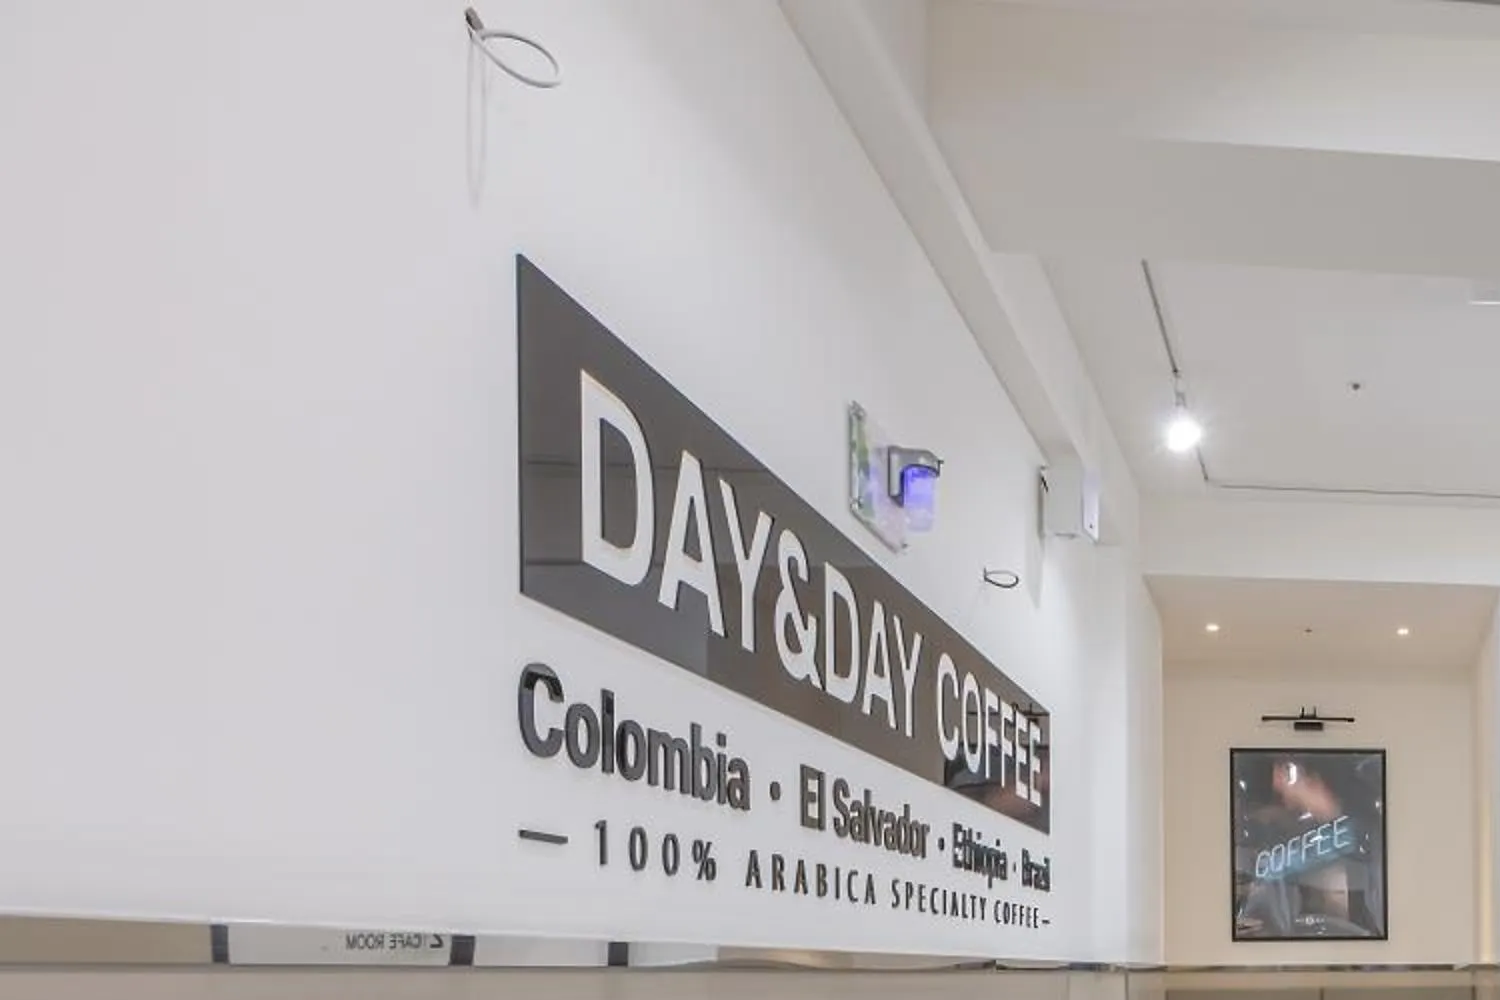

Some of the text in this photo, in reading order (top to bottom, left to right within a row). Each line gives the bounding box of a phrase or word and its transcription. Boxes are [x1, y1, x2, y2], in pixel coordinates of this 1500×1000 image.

[581, 368, 1042, 807] DAY&DAY COFFEE
[517, 662, 751, 811] Colombia
[800, 763, 826, 831] El
[833, 777, 931, 859] Salvador
[952, 822, 1007, 890] Ethiopia
[1255, 815, 1351, 878] COFFEE
[594, 819, 717, 881] 100%
[745, 849, 877, 905] ARABICA
[891, 878, 987, 921] SPECIALTY
